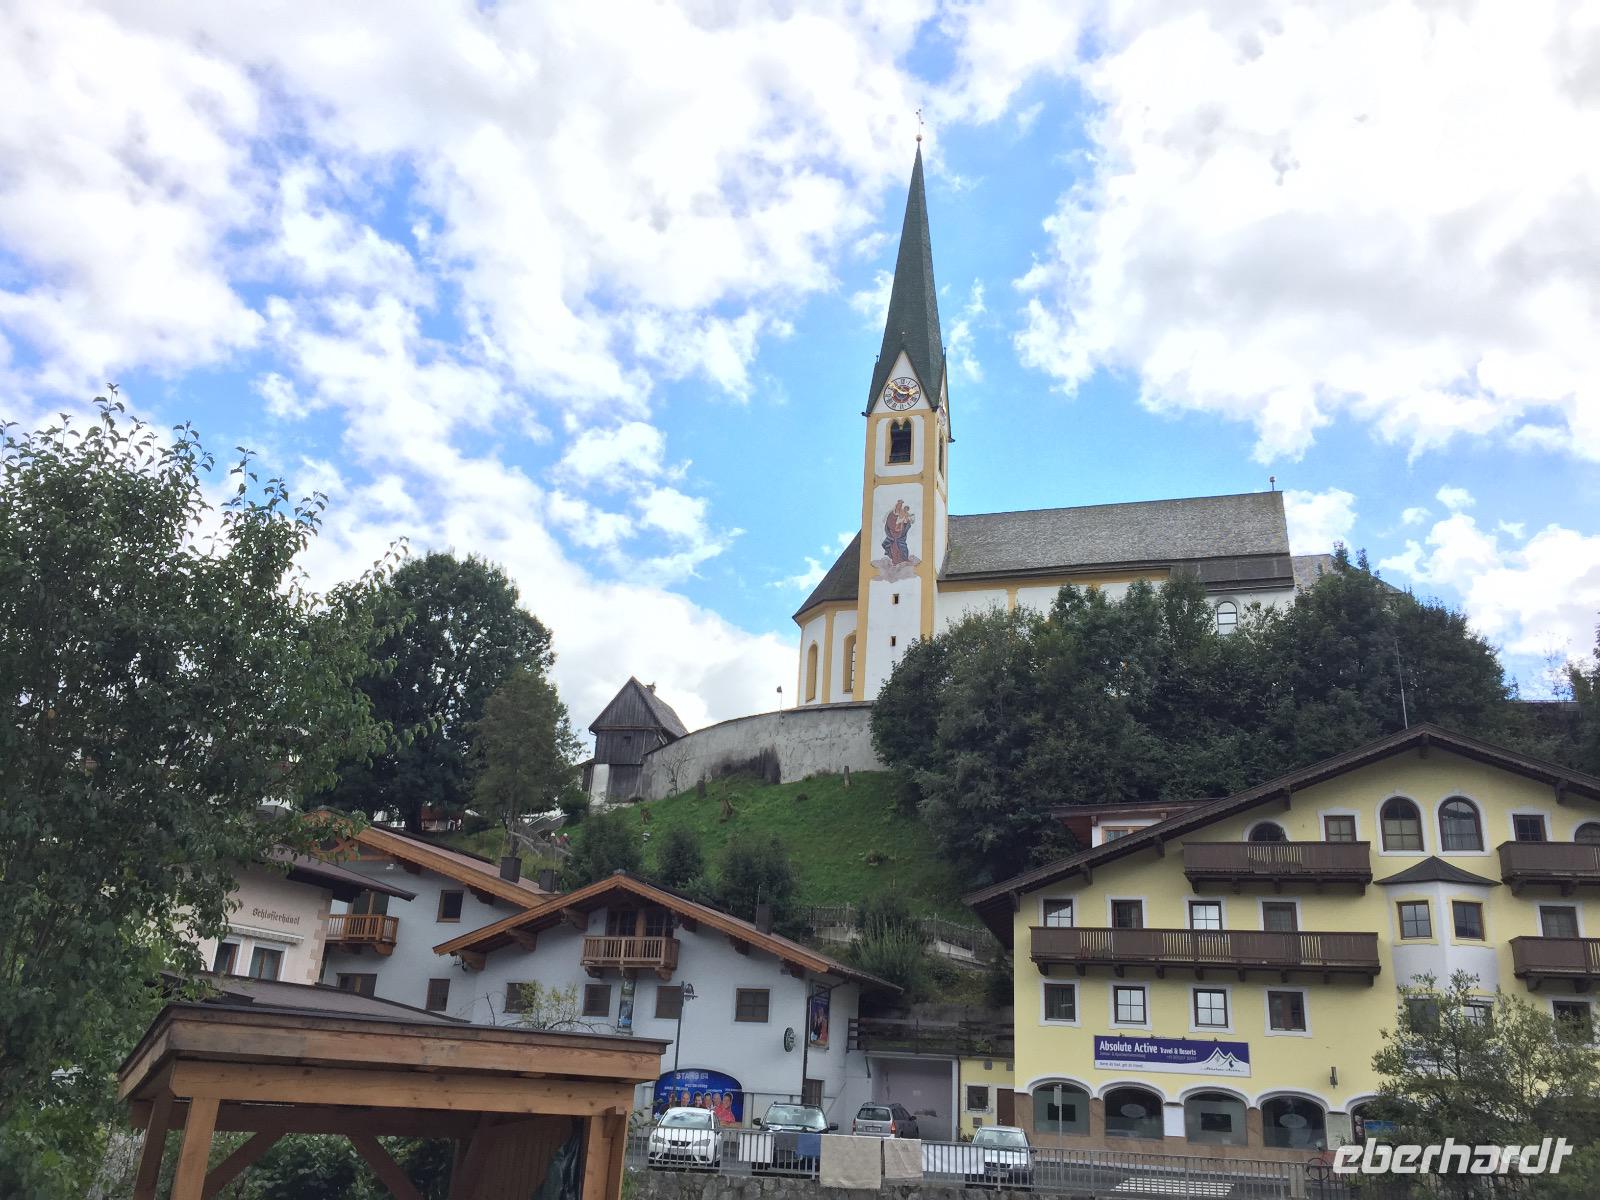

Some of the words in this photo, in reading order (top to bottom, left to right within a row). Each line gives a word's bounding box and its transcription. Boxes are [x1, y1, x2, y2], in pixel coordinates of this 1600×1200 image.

[1099, 1040, 1132, 1052] Absolute
[1134, 1042, 1158, 1053] Active
[1159, 1046, 1173, 1054] Travel
